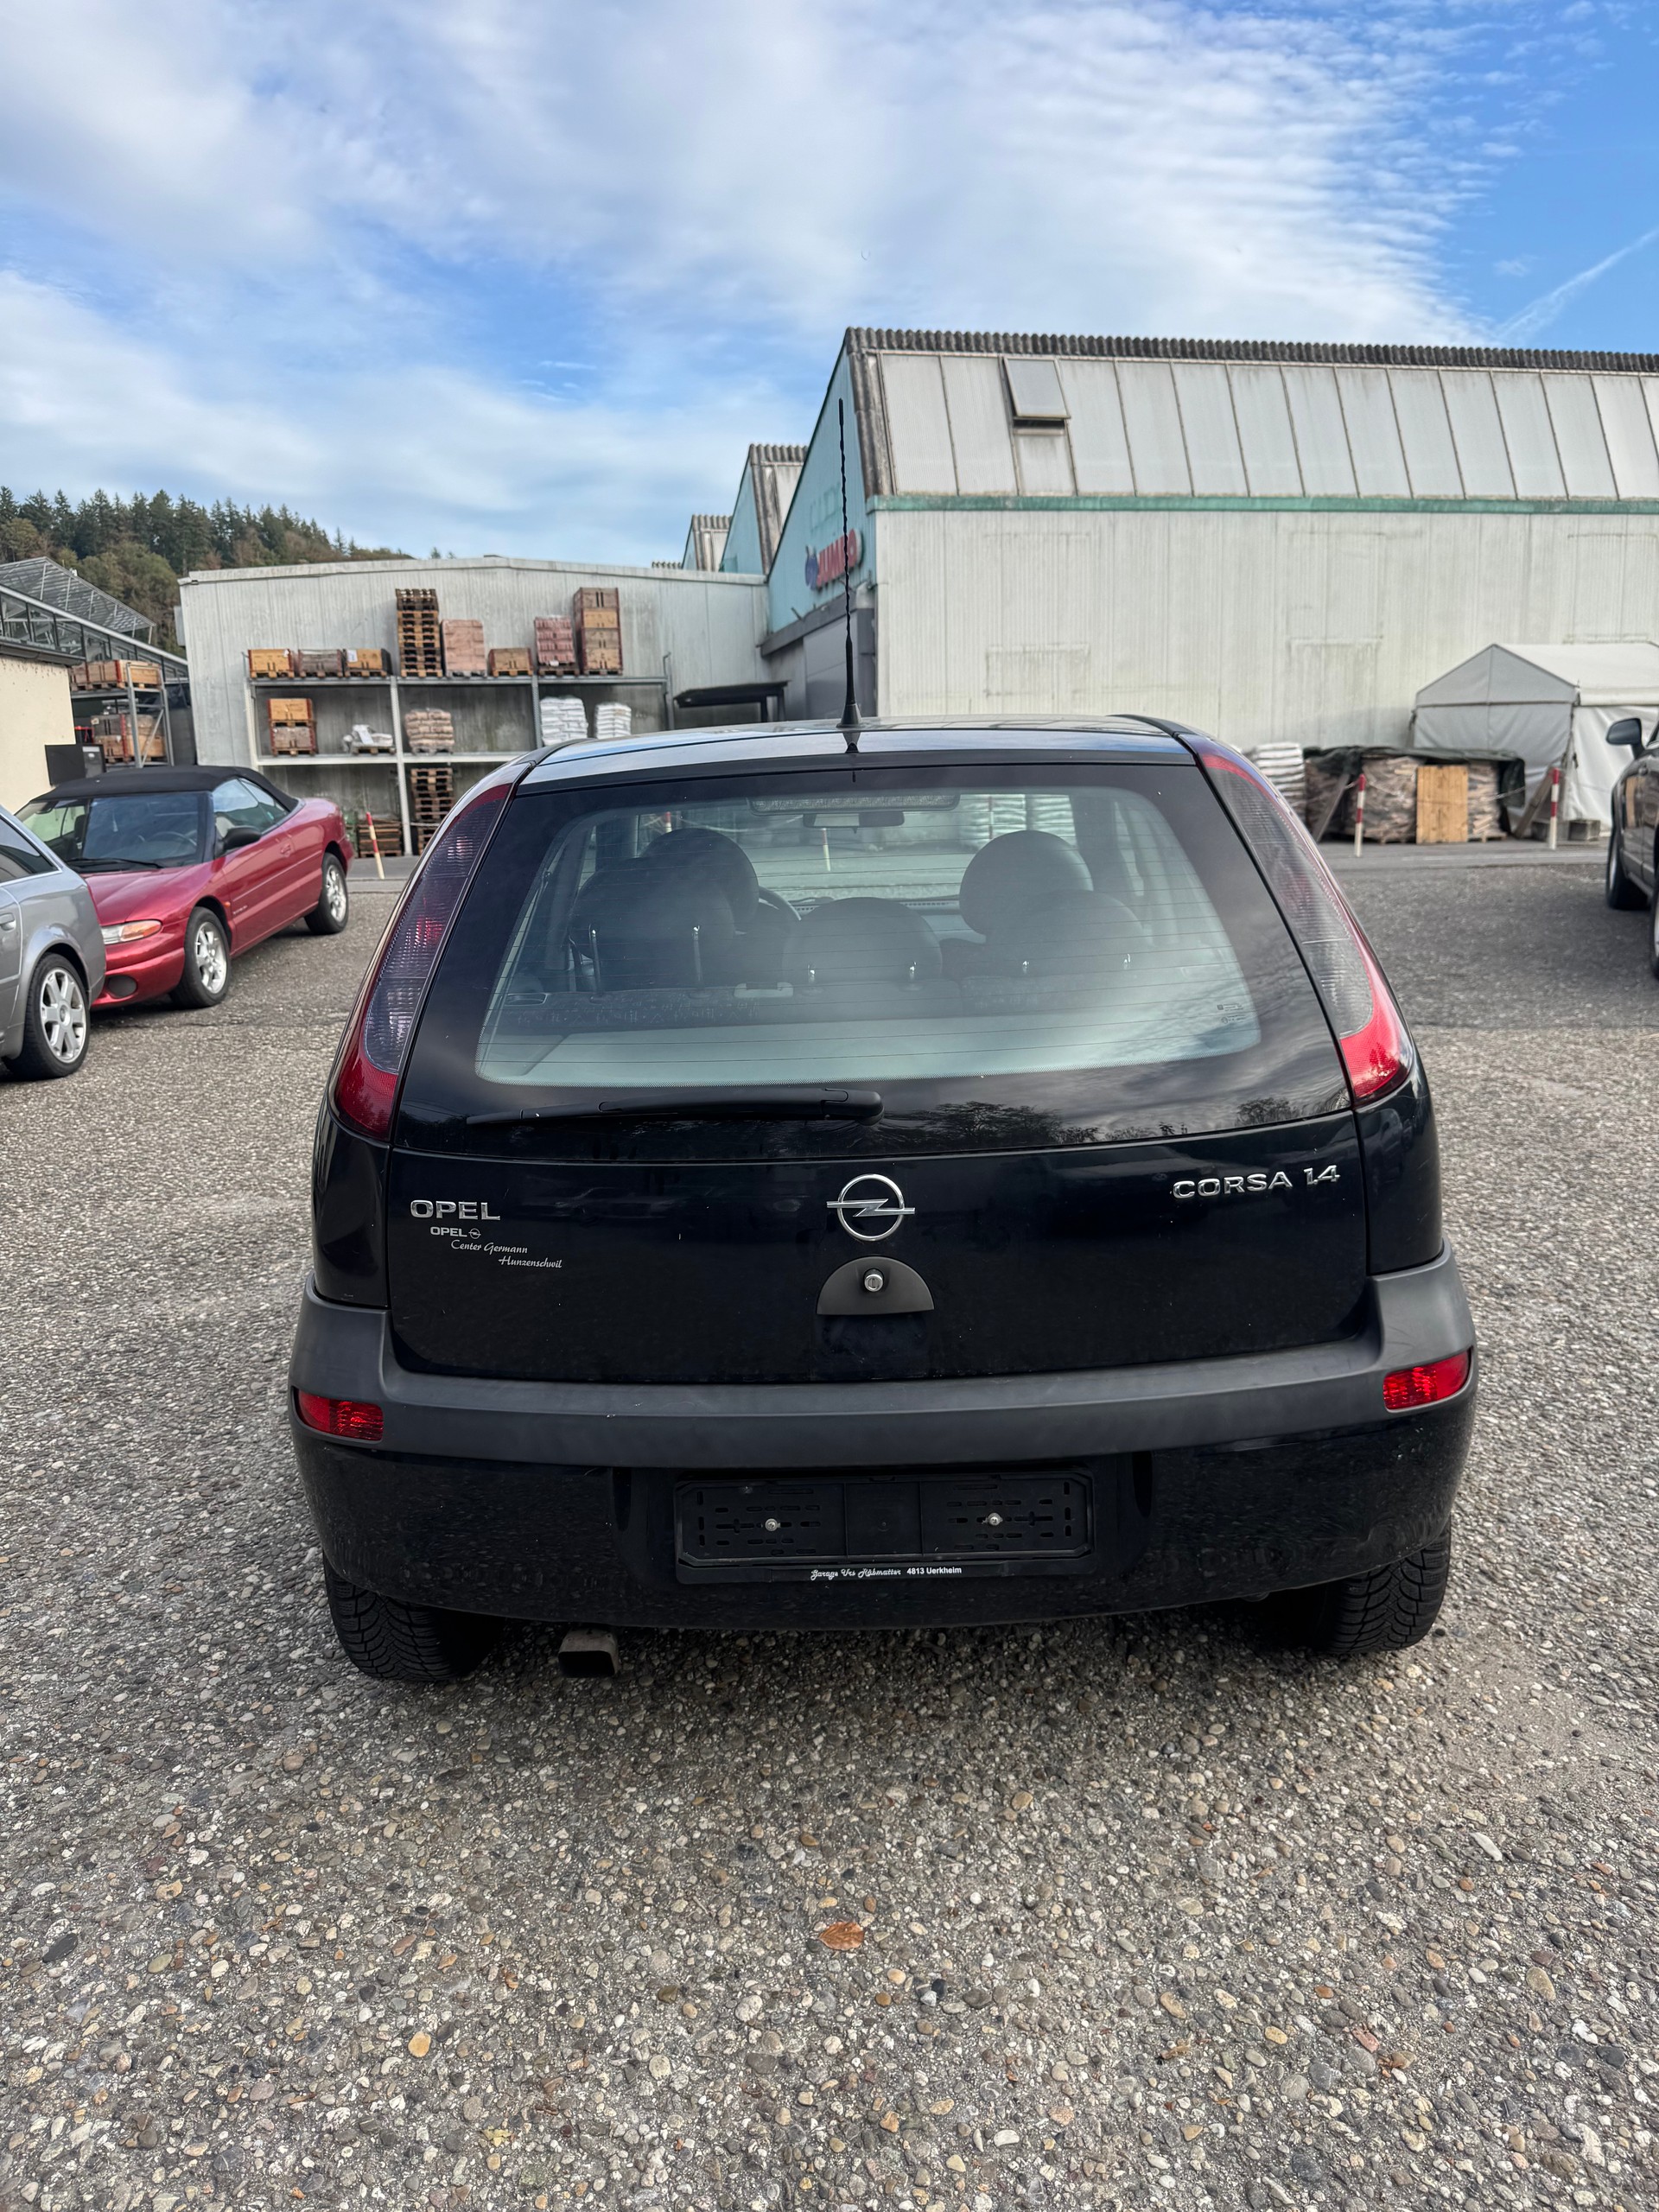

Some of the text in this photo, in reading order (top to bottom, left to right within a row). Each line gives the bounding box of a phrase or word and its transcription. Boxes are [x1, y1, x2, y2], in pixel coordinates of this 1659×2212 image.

[1173, 1171, 1294, 1199] CORSA
[410, 1199, 501, 1221] OPEL
[429, 1226, 467, 1237] OPEL
[450, 1239, 528, 1255] Center Germann
[498, 1255, 563, 1268] Hunzenschwil
[810, 1568, 839, 1581] Garage
[840, 1567, 856, 1577] Urs
[906, 1567, 925, 1575] 4813
[925, 1565, 963, 1575] Uerkheim
